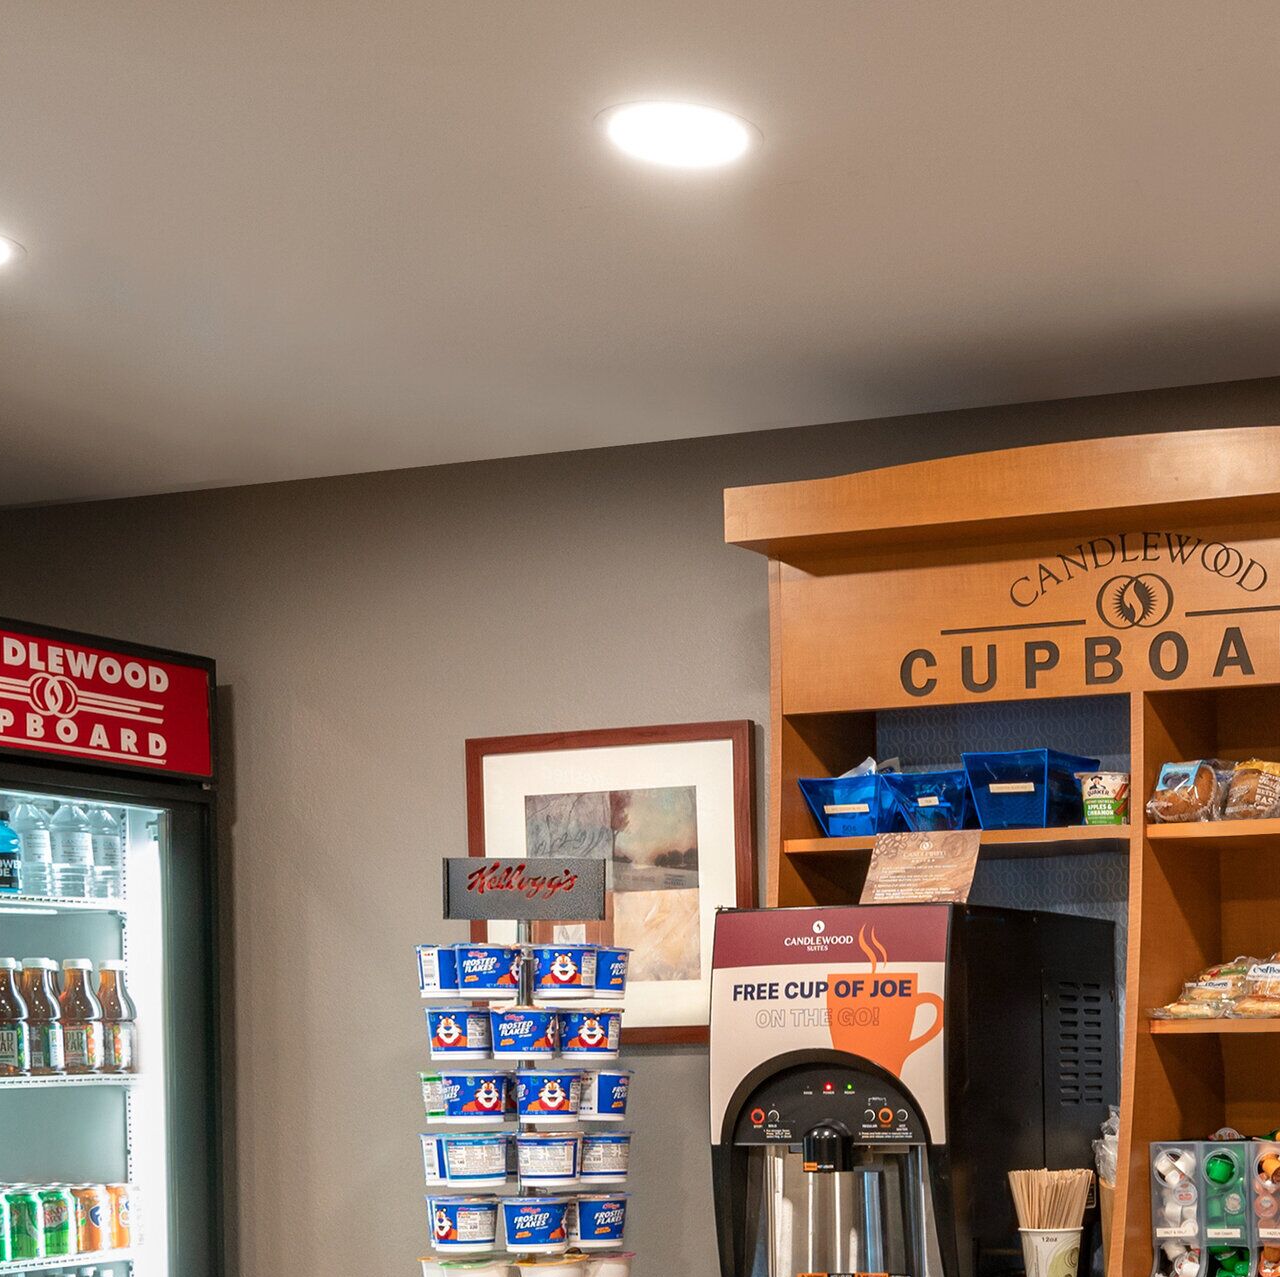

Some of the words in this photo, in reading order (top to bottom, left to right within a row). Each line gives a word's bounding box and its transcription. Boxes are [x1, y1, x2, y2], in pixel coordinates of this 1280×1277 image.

[1010, 531, 1268, 608] CANDLEWOOD
[1086, 789, 1110, 797] QUAKER
[467, 860, 578, 899] Kellogg's
[784, 934, 854, 947] CANDLEWOOD
[806, 944, 829, 952] SUITES
[462, 956, 498, 967] FROSTED
[464, 963, 494, 973] FLAKES
[732, 983, 780, 1002] FREE
[784, 981, 829, 1001] CUP
[834, 980, 864, 999] OF
[869, 979, 912, 998] JOE
[755, 1009, 786, 1030] ON
[791, 1008, 832, 1028] THE
[837, 1006, 880, 1027] GO!
[498, 1020, 533, 1030] FROSTED
[500, 1027, 531, 1037] FLAKES
[513, 1212, 550, 1224] FROSTED
[516, 1219, 547, 1229] FLAKES
